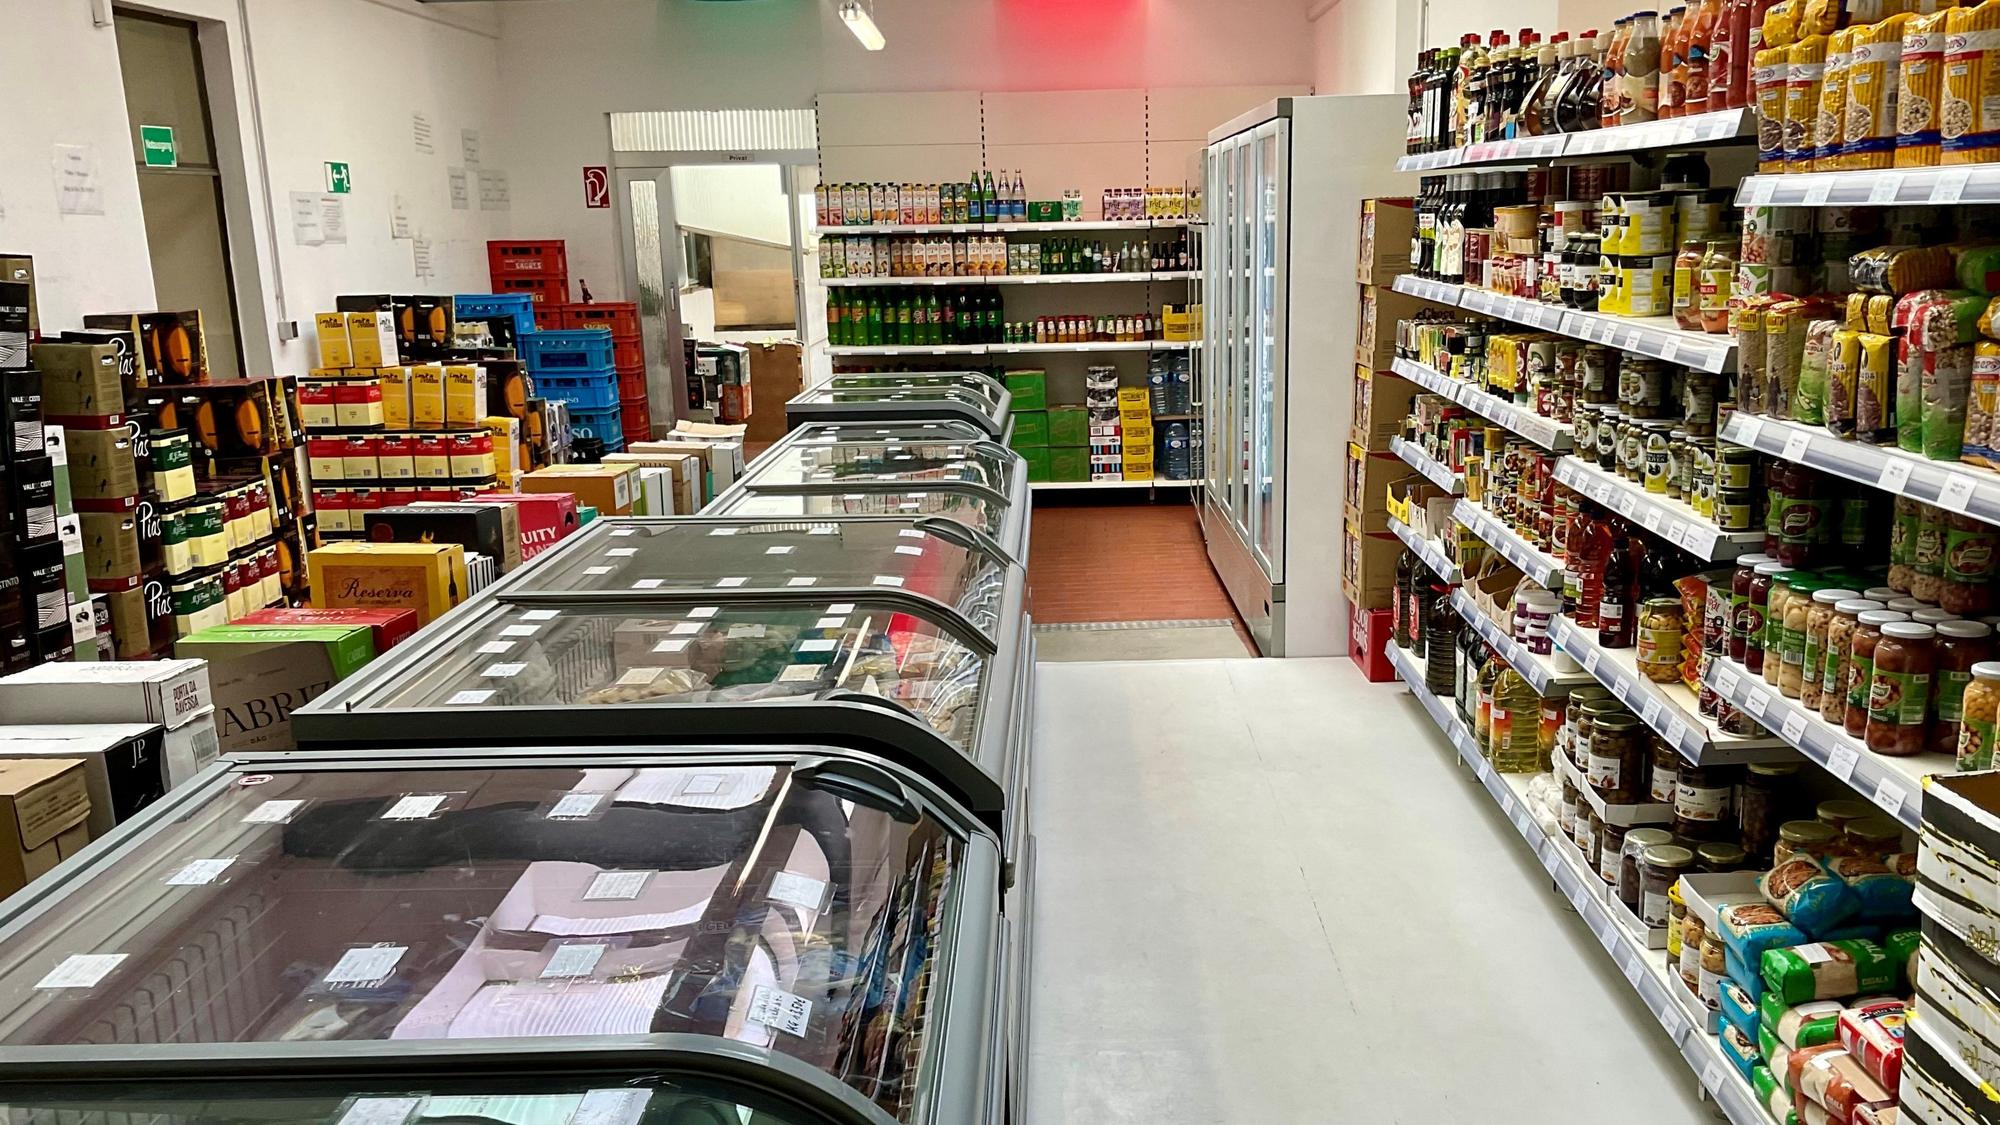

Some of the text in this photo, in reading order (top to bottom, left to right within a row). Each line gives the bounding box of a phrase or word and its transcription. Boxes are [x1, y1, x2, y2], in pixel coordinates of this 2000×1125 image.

[136, 502, 162, 540] Pias
[144, 581, 172, 620] Pias
[338, 577, 414, 600] Reserva
[173, 680, 198, 701] PORTA DA
[175, 693, 200, 716] RAVESSA
[215, 680, 331, 739] ABRIZ
[131, 739, 146, 769] JP
